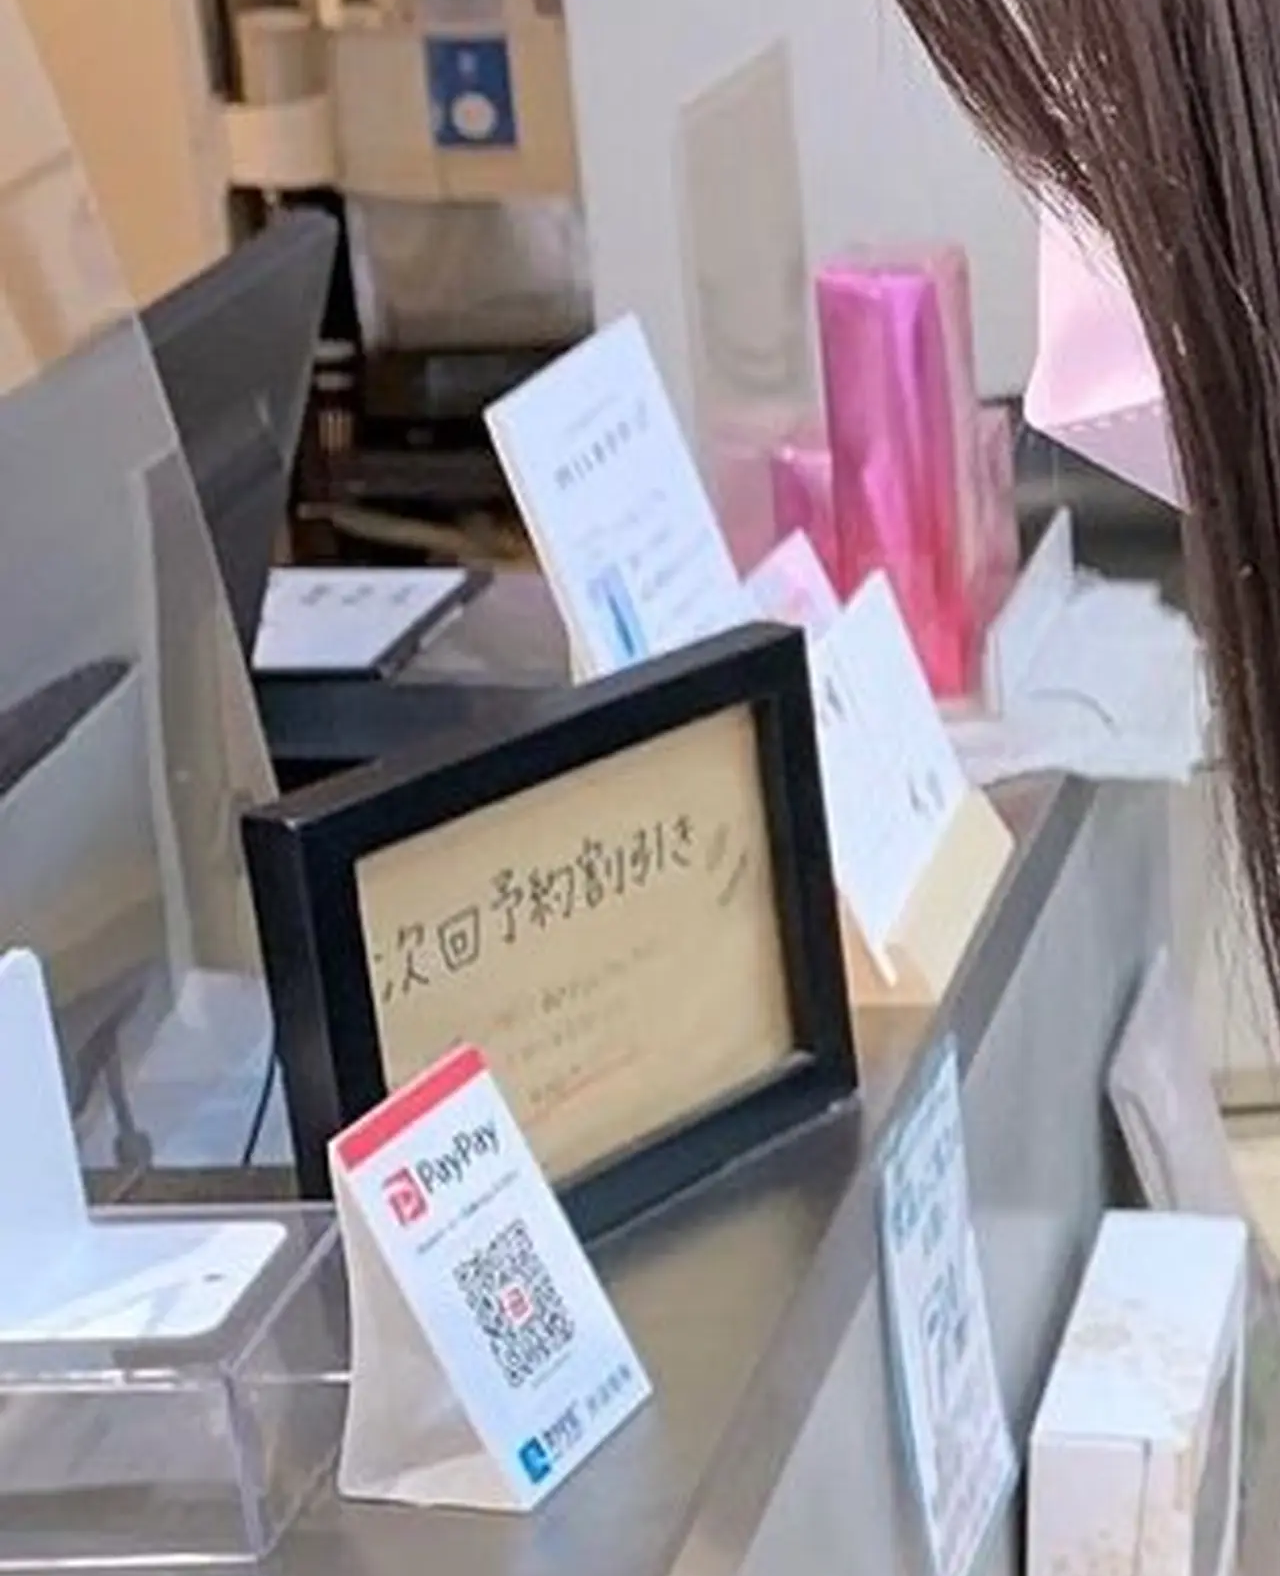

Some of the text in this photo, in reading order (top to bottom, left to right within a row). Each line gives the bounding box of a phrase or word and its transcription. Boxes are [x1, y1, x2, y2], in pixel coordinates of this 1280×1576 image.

[373, 814, 695, 1004] 次回予約割引き
[415, 1117, 500, 1195] PayPay
